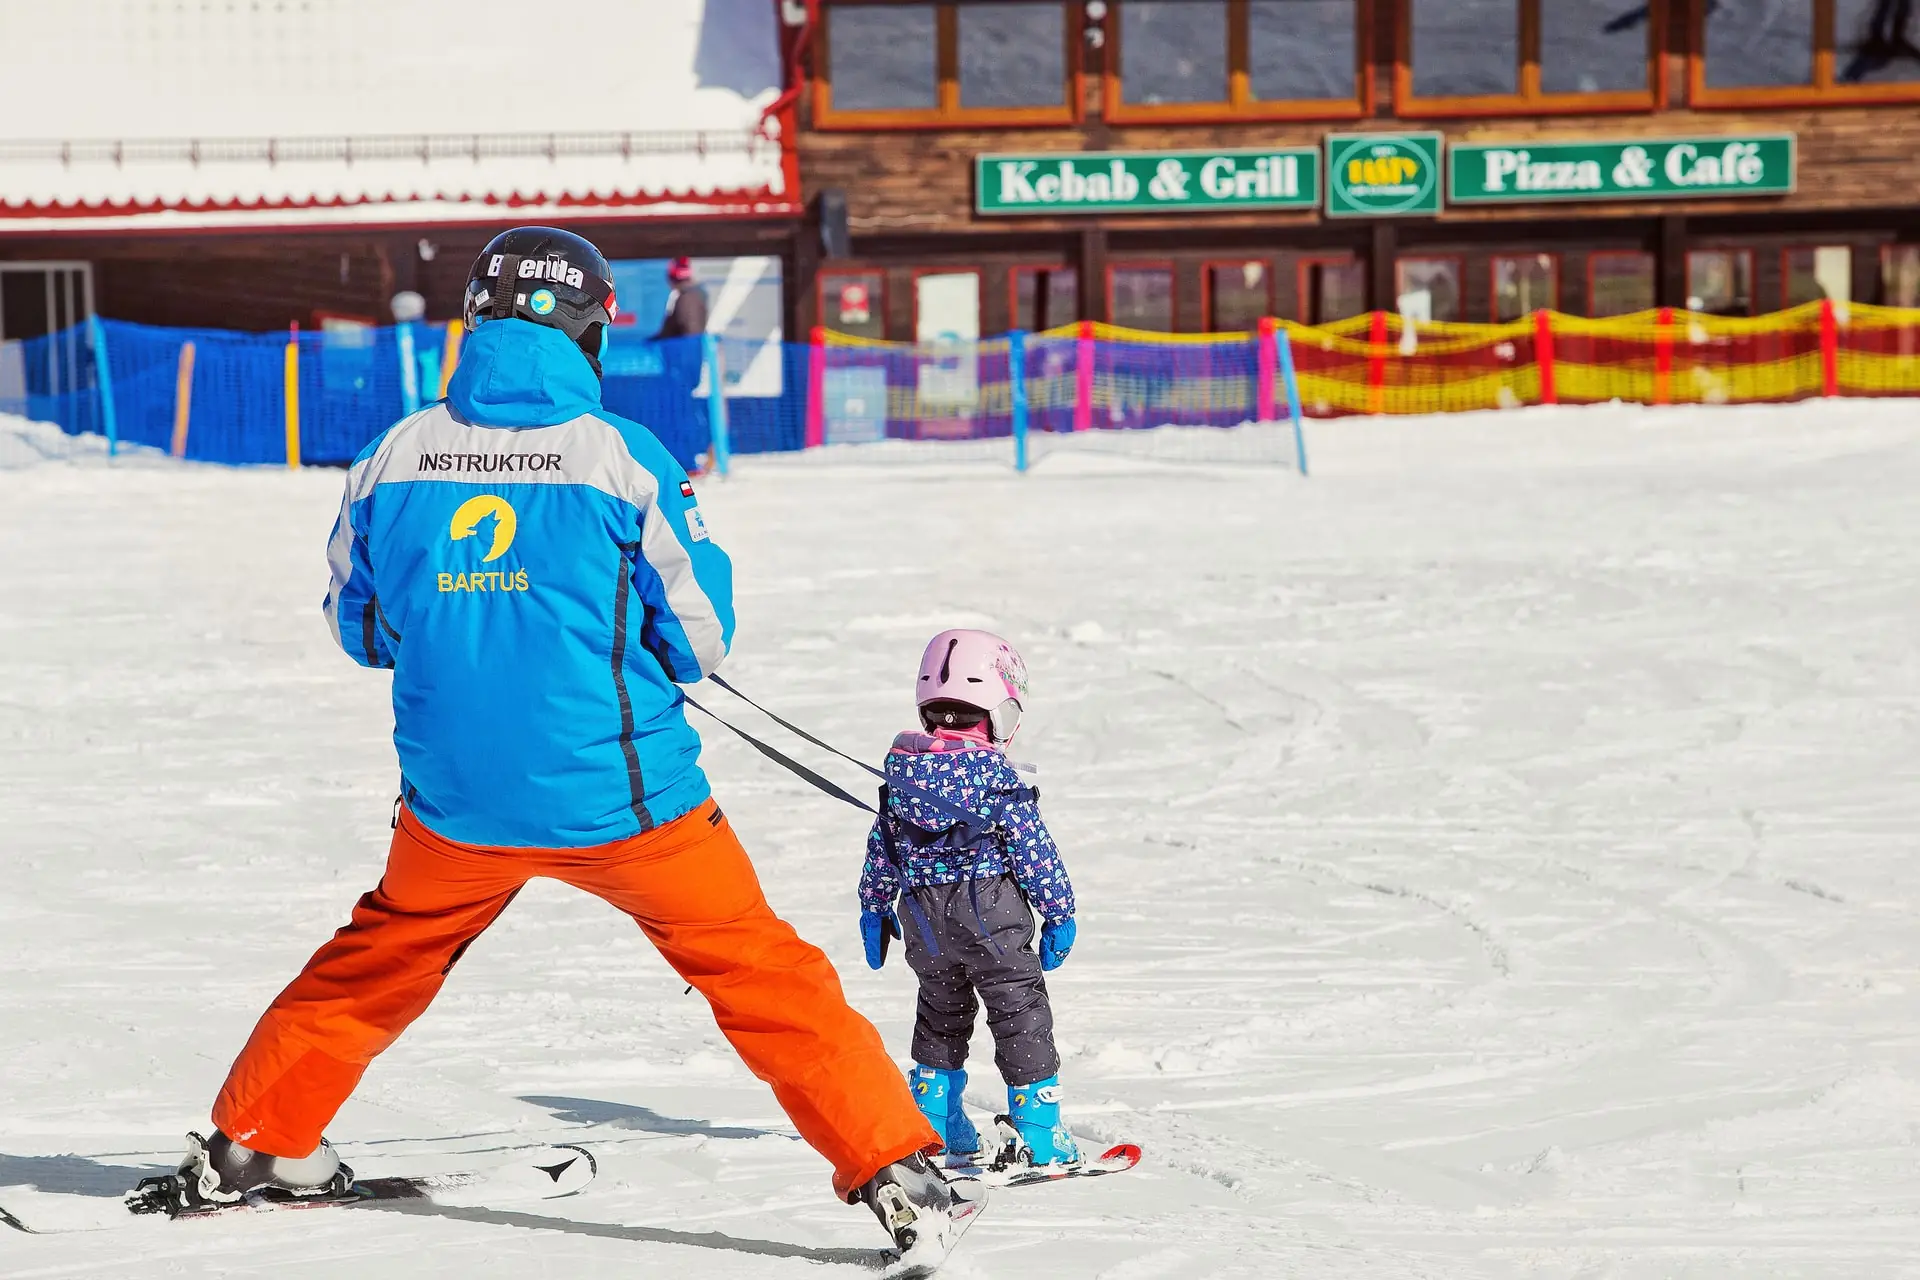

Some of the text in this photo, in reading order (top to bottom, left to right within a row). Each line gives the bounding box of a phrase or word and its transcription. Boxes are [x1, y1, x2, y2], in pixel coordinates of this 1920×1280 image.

[998, 159, 1139, 203] Kebab
[1148, 159, 1191, 200] &
[1200, 155, 1298, 199] Grill
[1482, 142, 1764, 192] Pizza & Café
[418, 453, 562, 472] INSTRUKTOR
[438, 567, 529, 593] BARTUŚ
